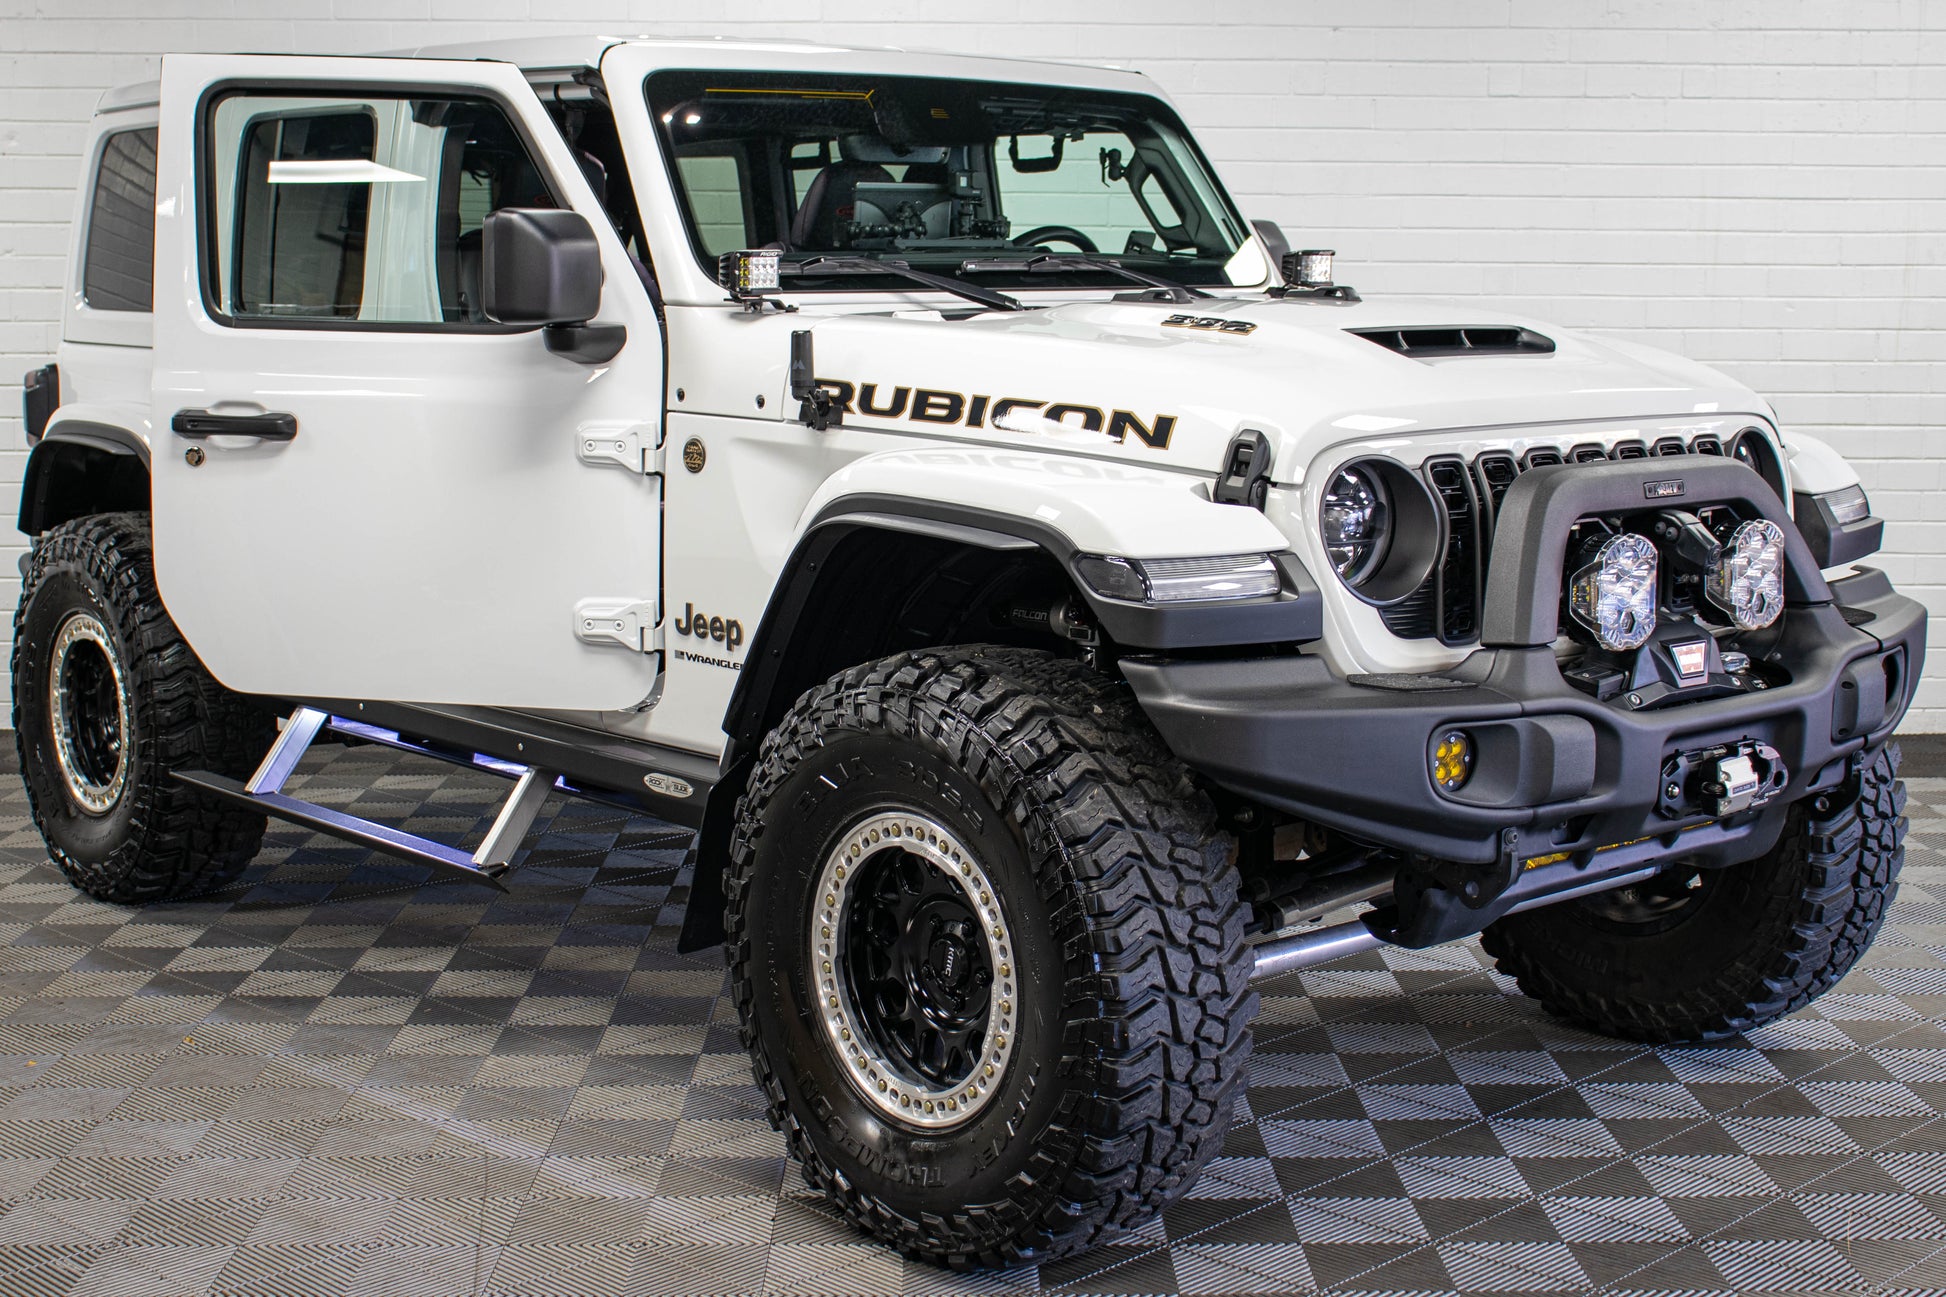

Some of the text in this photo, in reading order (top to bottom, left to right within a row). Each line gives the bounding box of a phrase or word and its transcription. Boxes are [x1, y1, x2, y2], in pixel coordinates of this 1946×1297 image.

[1161, 314, 1258, 336] 392
[813, 377, 1178, 450] RUBICON
[1012, 608, 1048, 621] FALCON
[675, 602, 744, 652] Jeep
[686, 651, 743, 671] WRANGLE
